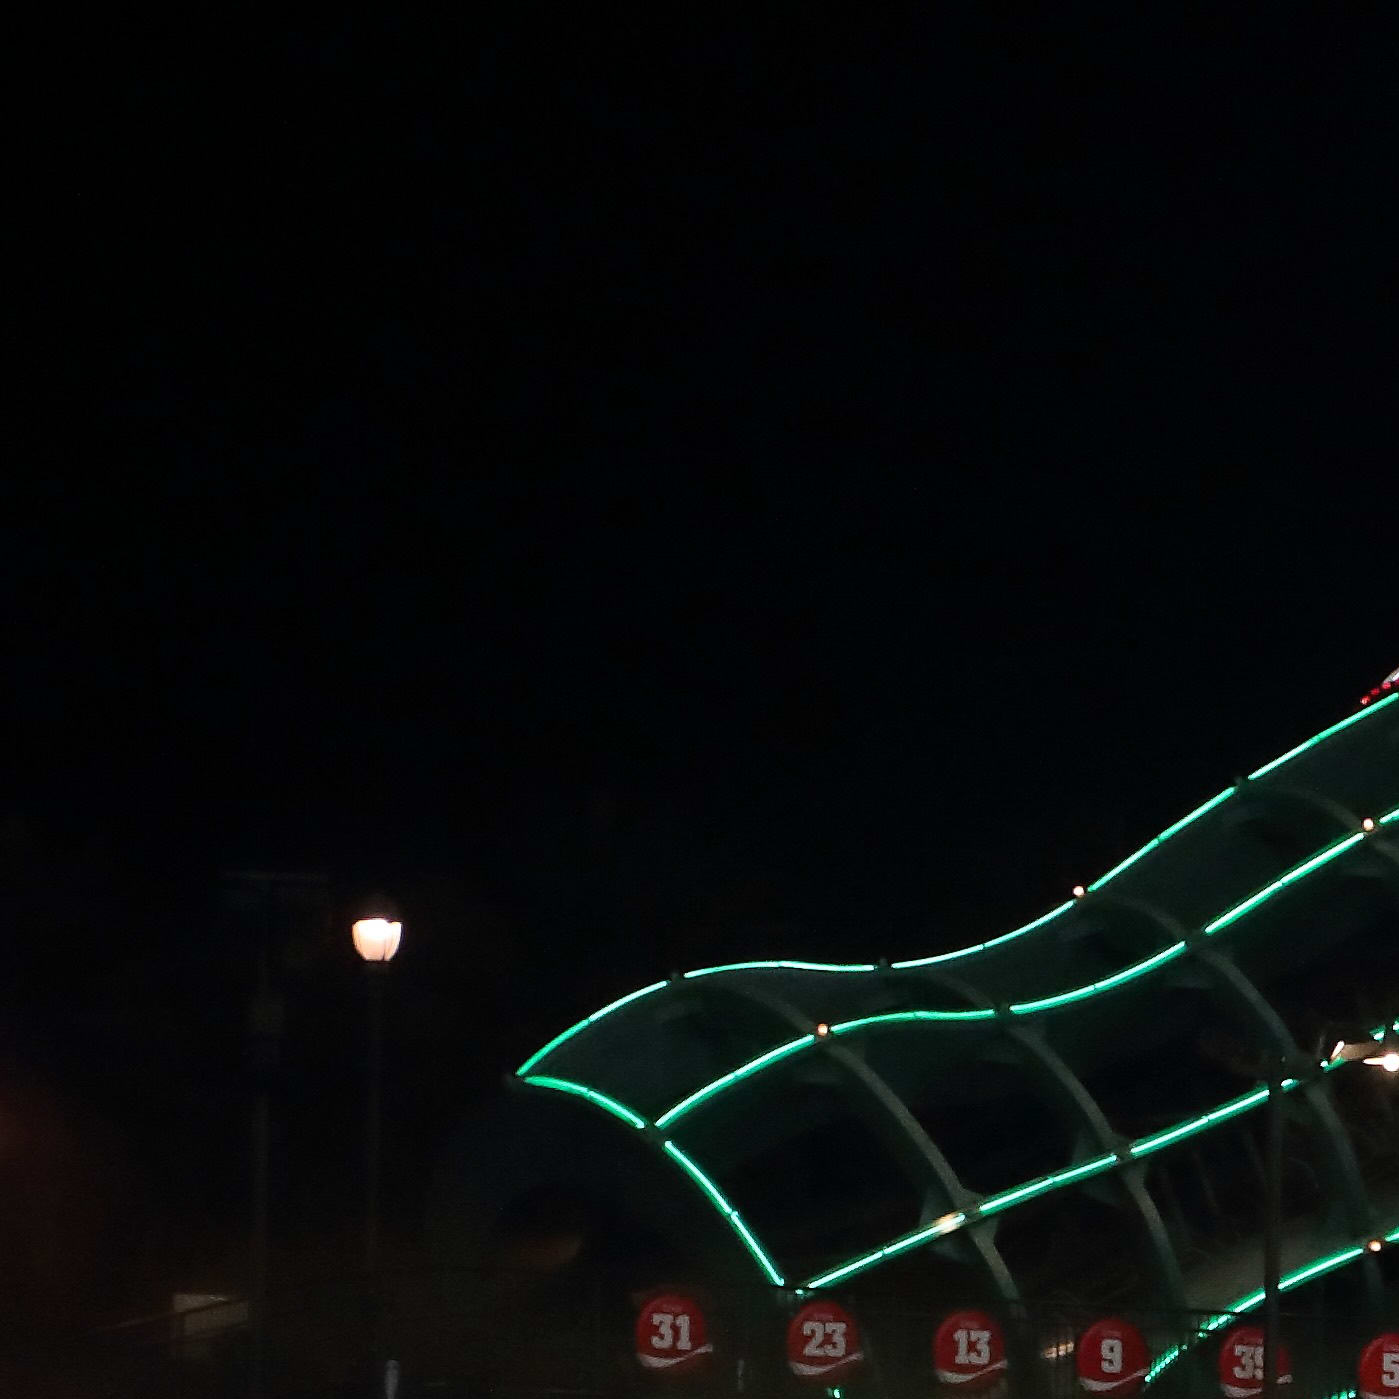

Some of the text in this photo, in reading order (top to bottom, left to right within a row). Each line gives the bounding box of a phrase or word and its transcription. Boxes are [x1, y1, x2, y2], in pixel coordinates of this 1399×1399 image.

[651, 1312, 690, 1352] 31
[803, 1321, 846, 1358] 23
[953, 1328, 991, 1365] 13
[1100, 1339, 1123, 1373] 9
